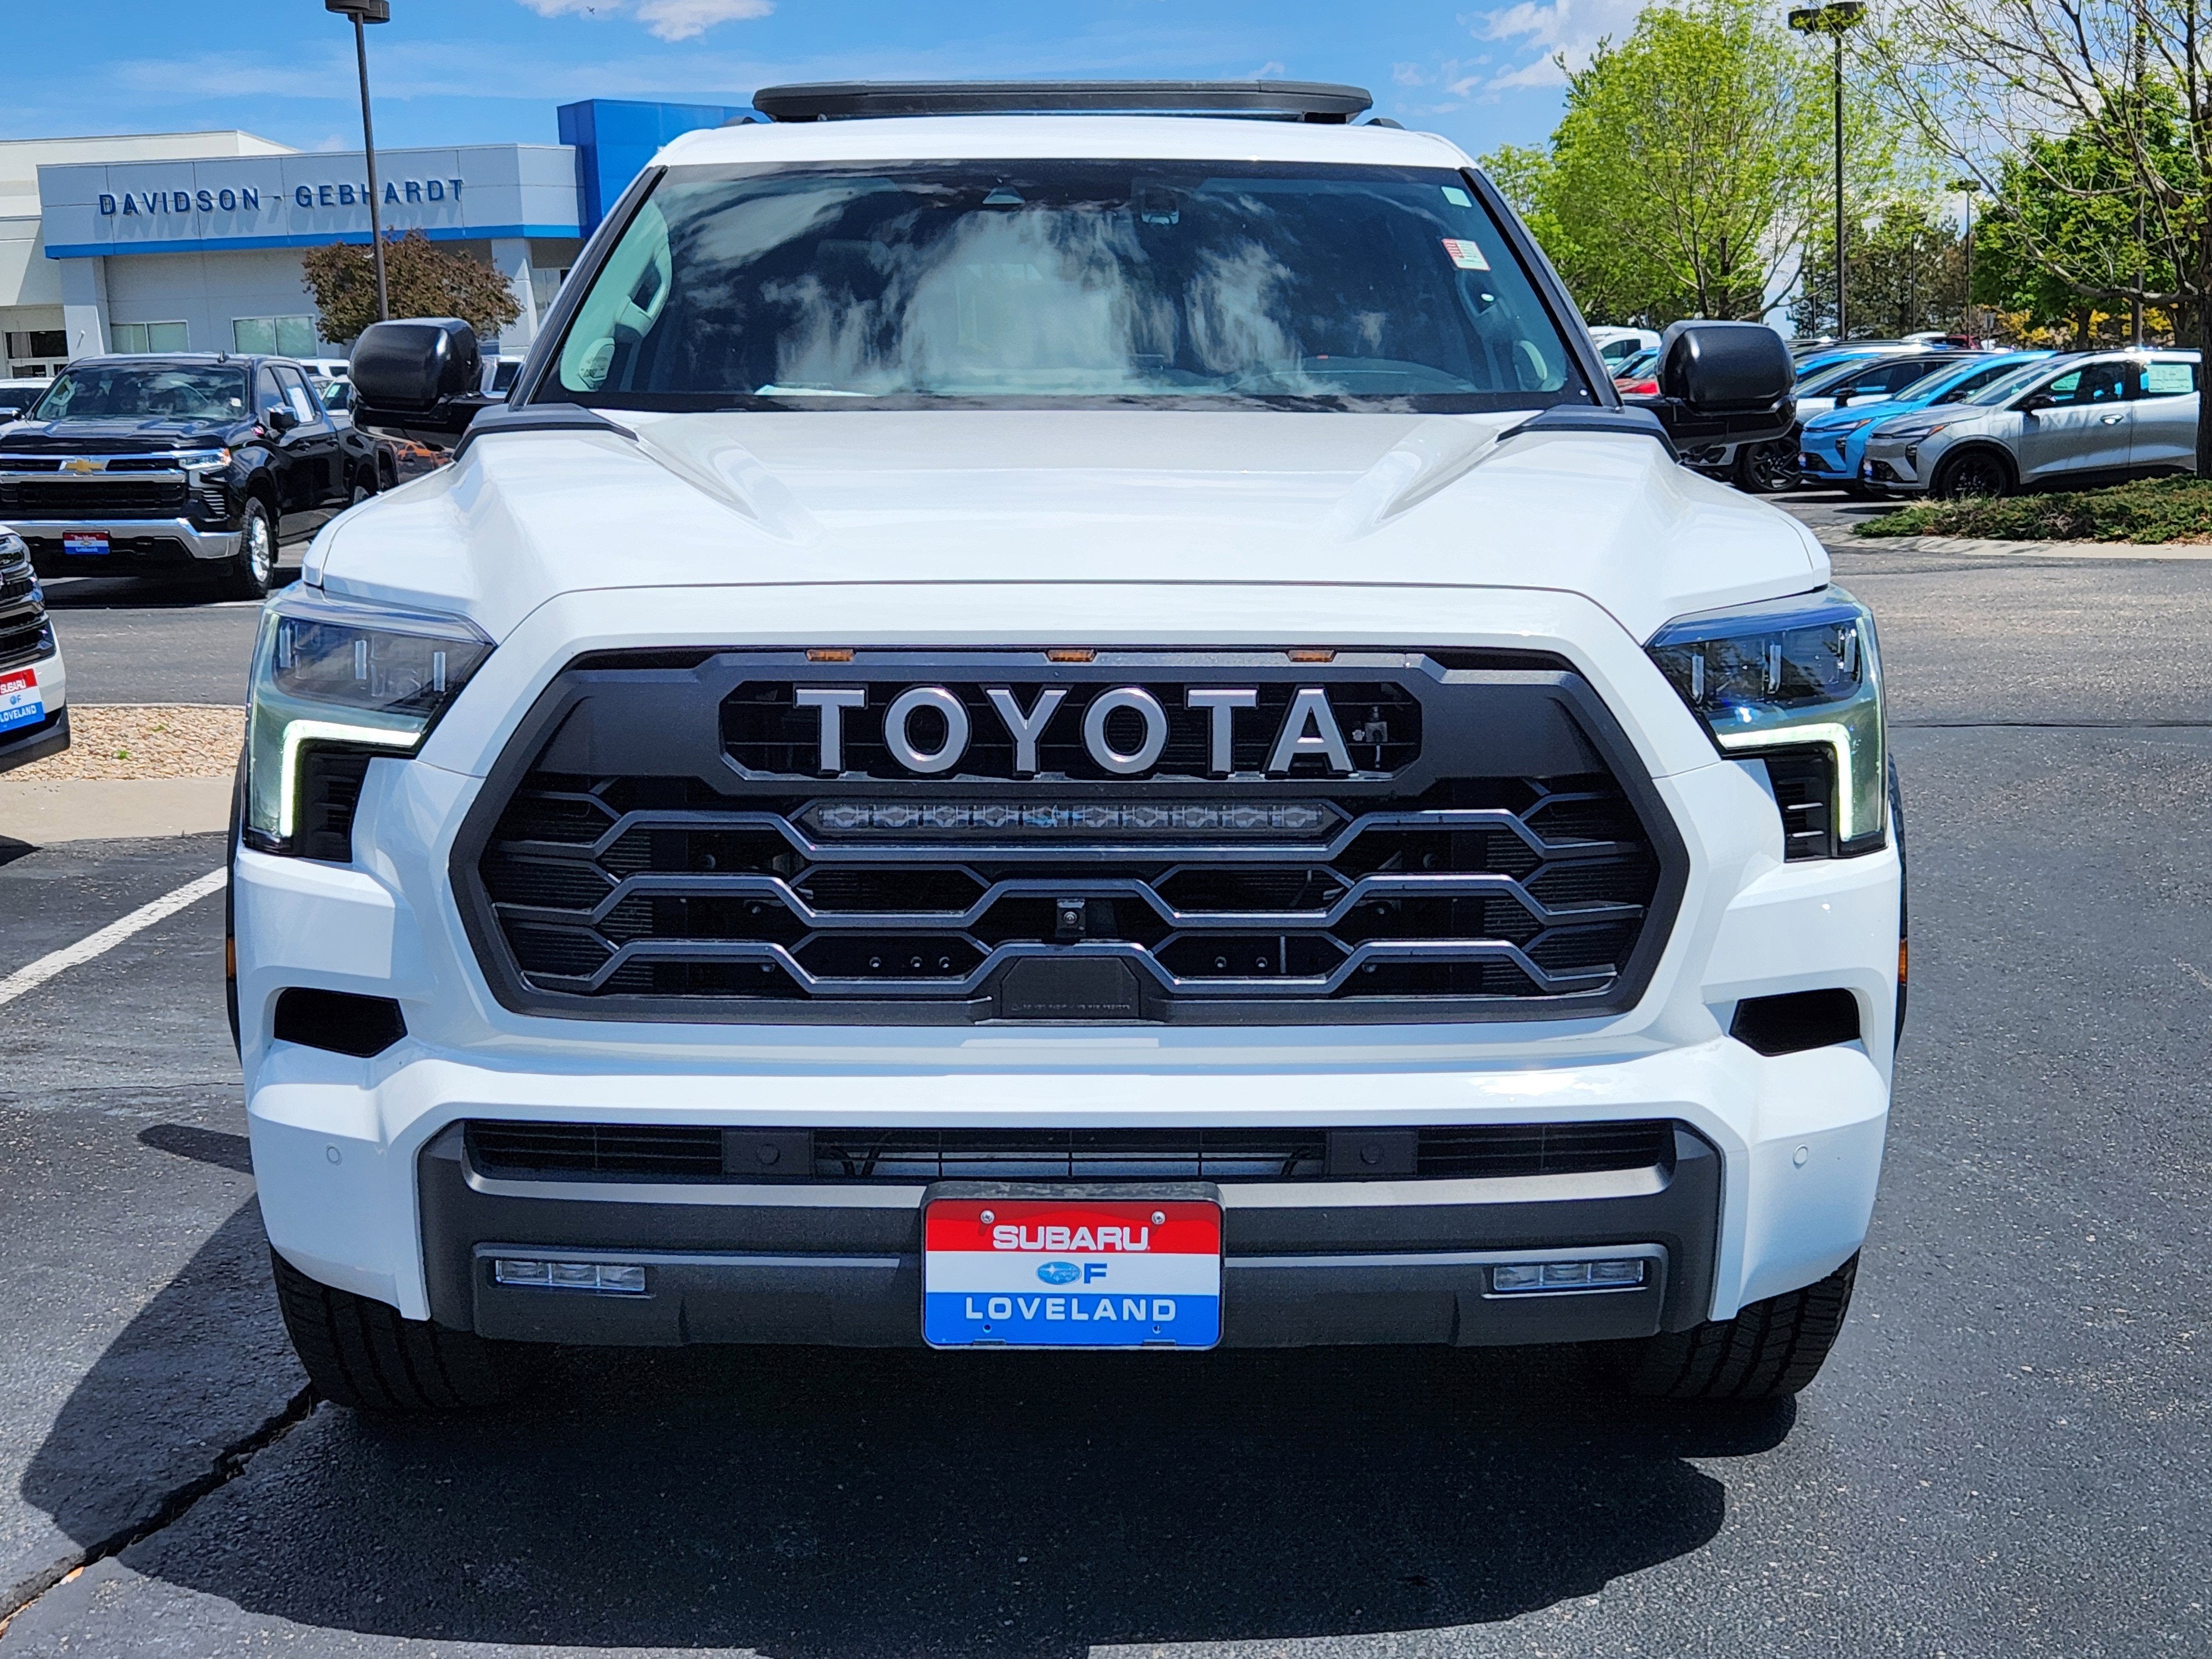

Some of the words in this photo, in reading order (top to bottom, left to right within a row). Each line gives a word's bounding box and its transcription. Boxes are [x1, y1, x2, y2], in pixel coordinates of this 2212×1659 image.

[99, 187, 260, 216] DAVIDSON
[1, 679, 26, 694] SUBARU
[0, 705, 37, 723] LOVELAND
[795, 686, 1355, 774] TOYOTA
[993, 1225, 1149, 1251] SUBARU
[966, 1297, 1176, 1322] LOVELAND
